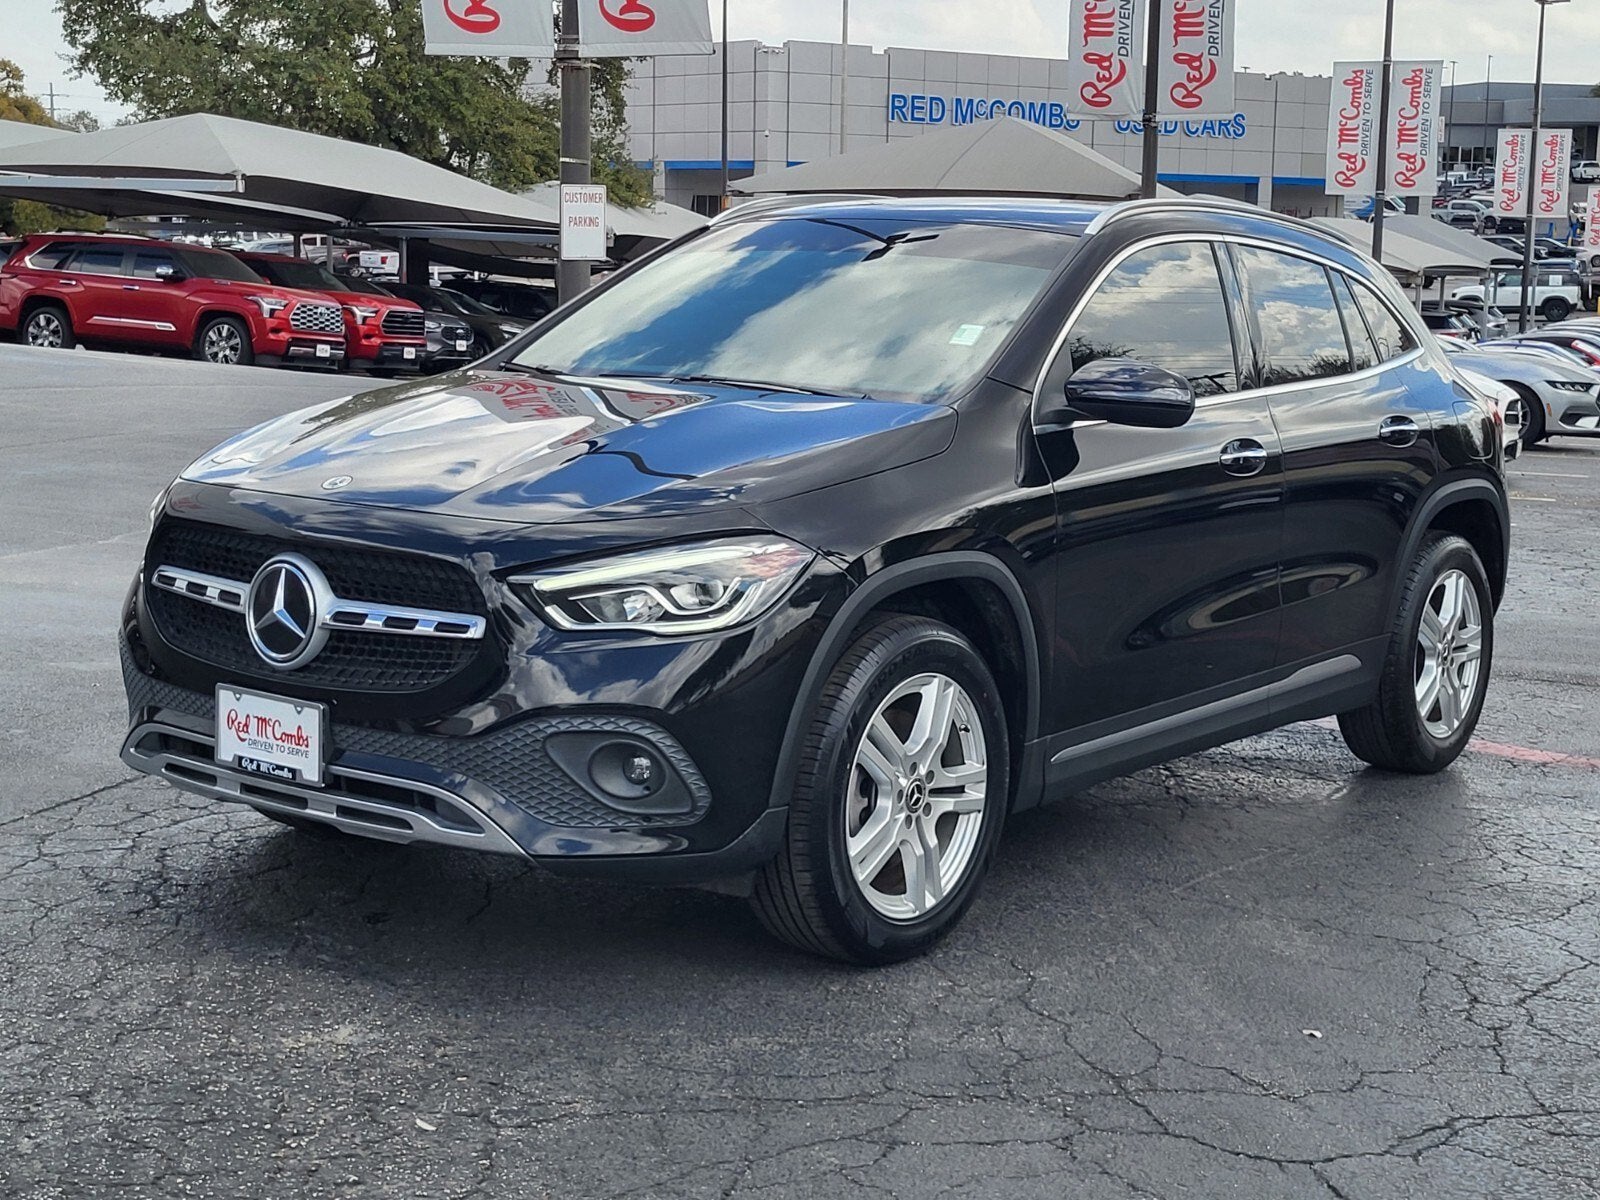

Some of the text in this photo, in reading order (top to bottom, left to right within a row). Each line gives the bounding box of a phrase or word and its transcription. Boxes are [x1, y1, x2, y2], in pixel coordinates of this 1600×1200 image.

[1118, 0, 1131, 57] DRIVEN
[1208, 0, 1220, 56] DRIVEN
[1080, 0, 1126, 108] Red Mc
[1170, 0, 1216, 108] Red Mc
[890, 93, 946, 124] RED
[1185, 113, 1246, 138] CARS
[1338, 69, 1364, 149] McCombs
[1361, 69, 1373, 156] DRIVEN TO SERVE
[1420, 67, 1433, 156] DRIVEN TO SERVE
[1395, 68, 1426, 188] Red McCombs
[1335, 152, 1366, 188] Red
[565, 192, 603, 203] CUSTOMER
[1500, 189, 1520, 211] Red
[1539, 189, 1560, 212] Red
[568, 216, 599, 227] PARKING
[227, 709, 309, 748] Red McCombs
[242, 757, 257, 771] Red
[248, 738, 310, 758] DRIVEN TO SERVE
